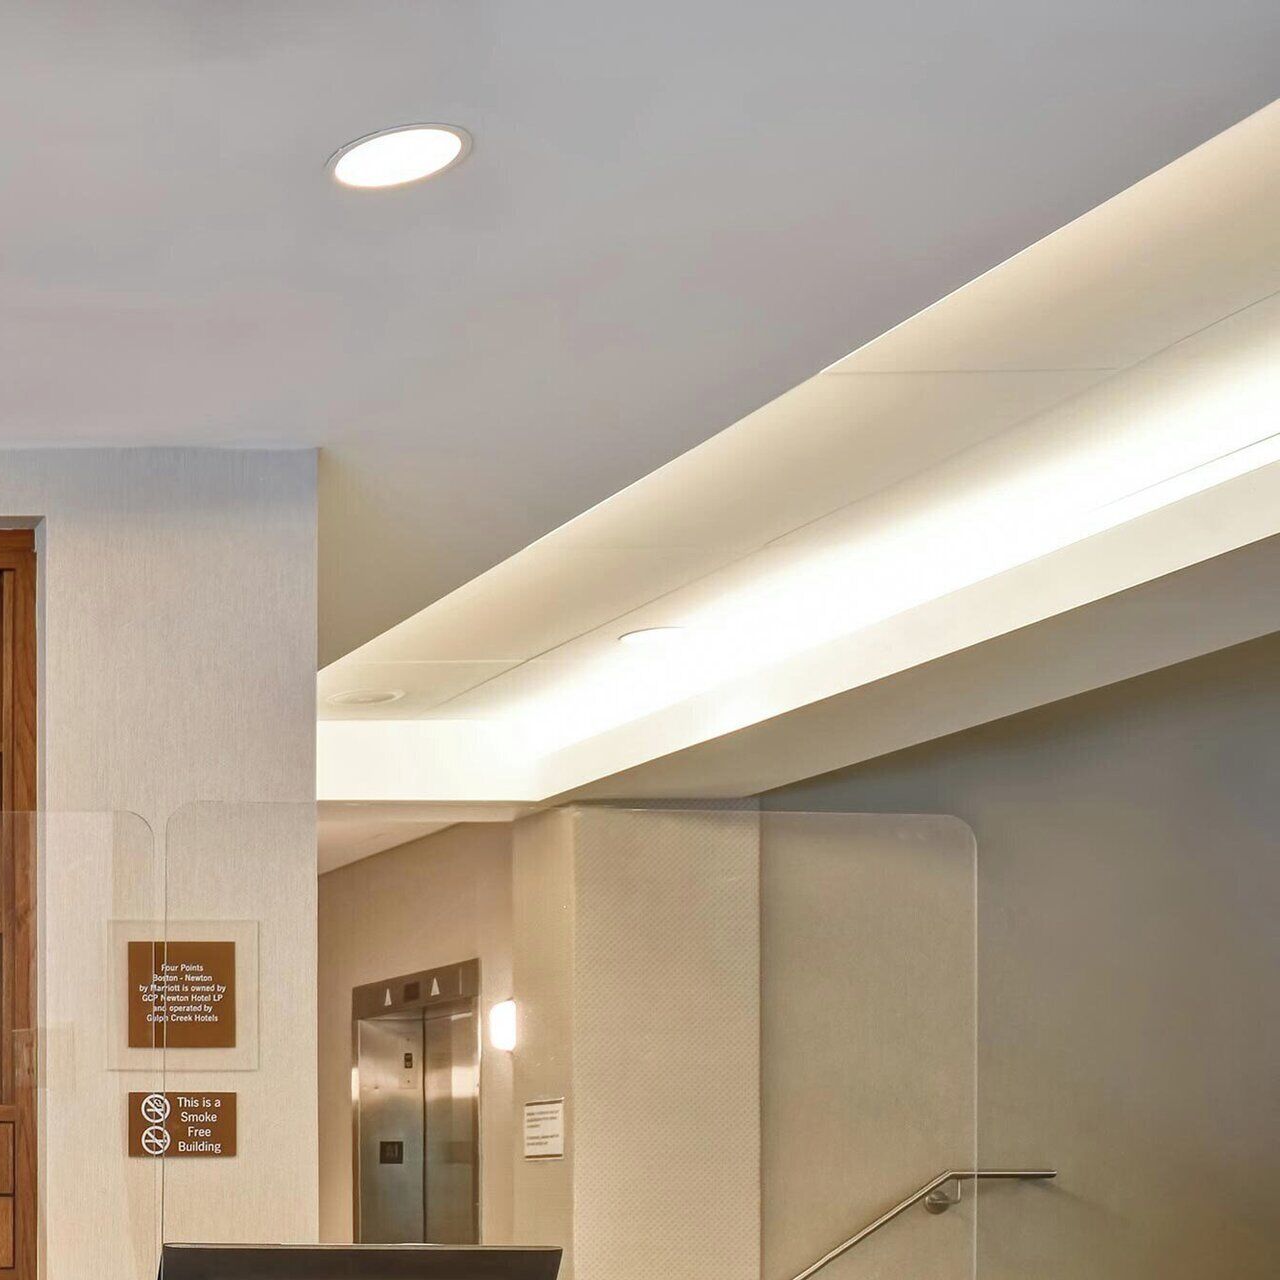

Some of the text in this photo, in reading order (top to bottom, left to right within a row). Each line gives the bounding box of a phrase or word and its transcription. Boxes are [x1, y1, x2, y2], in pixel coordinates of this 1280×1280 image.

[161, 963, 203, 971] Four Points
[152, 973, 178, 981] Boston
[185, 973, 212, 981] Newton
[139, 984, 226, 993] by Marriott is owned by
[142, 994, 223, 1002] GCP Newton Hotel LP
[169, 1004, 202, 1012] operated
[204, 1004, 213, 1013] by
[171, 1014, 193, 1022] Creek
[195, 1014, 218, 1022] Hotels
[177, 1097, 221, 1107] This is a
[181, 1111, 217, 1122] Smoke
[188, 1126, 211, 1137] Free
[178, 1141, 221, 1154] Building
